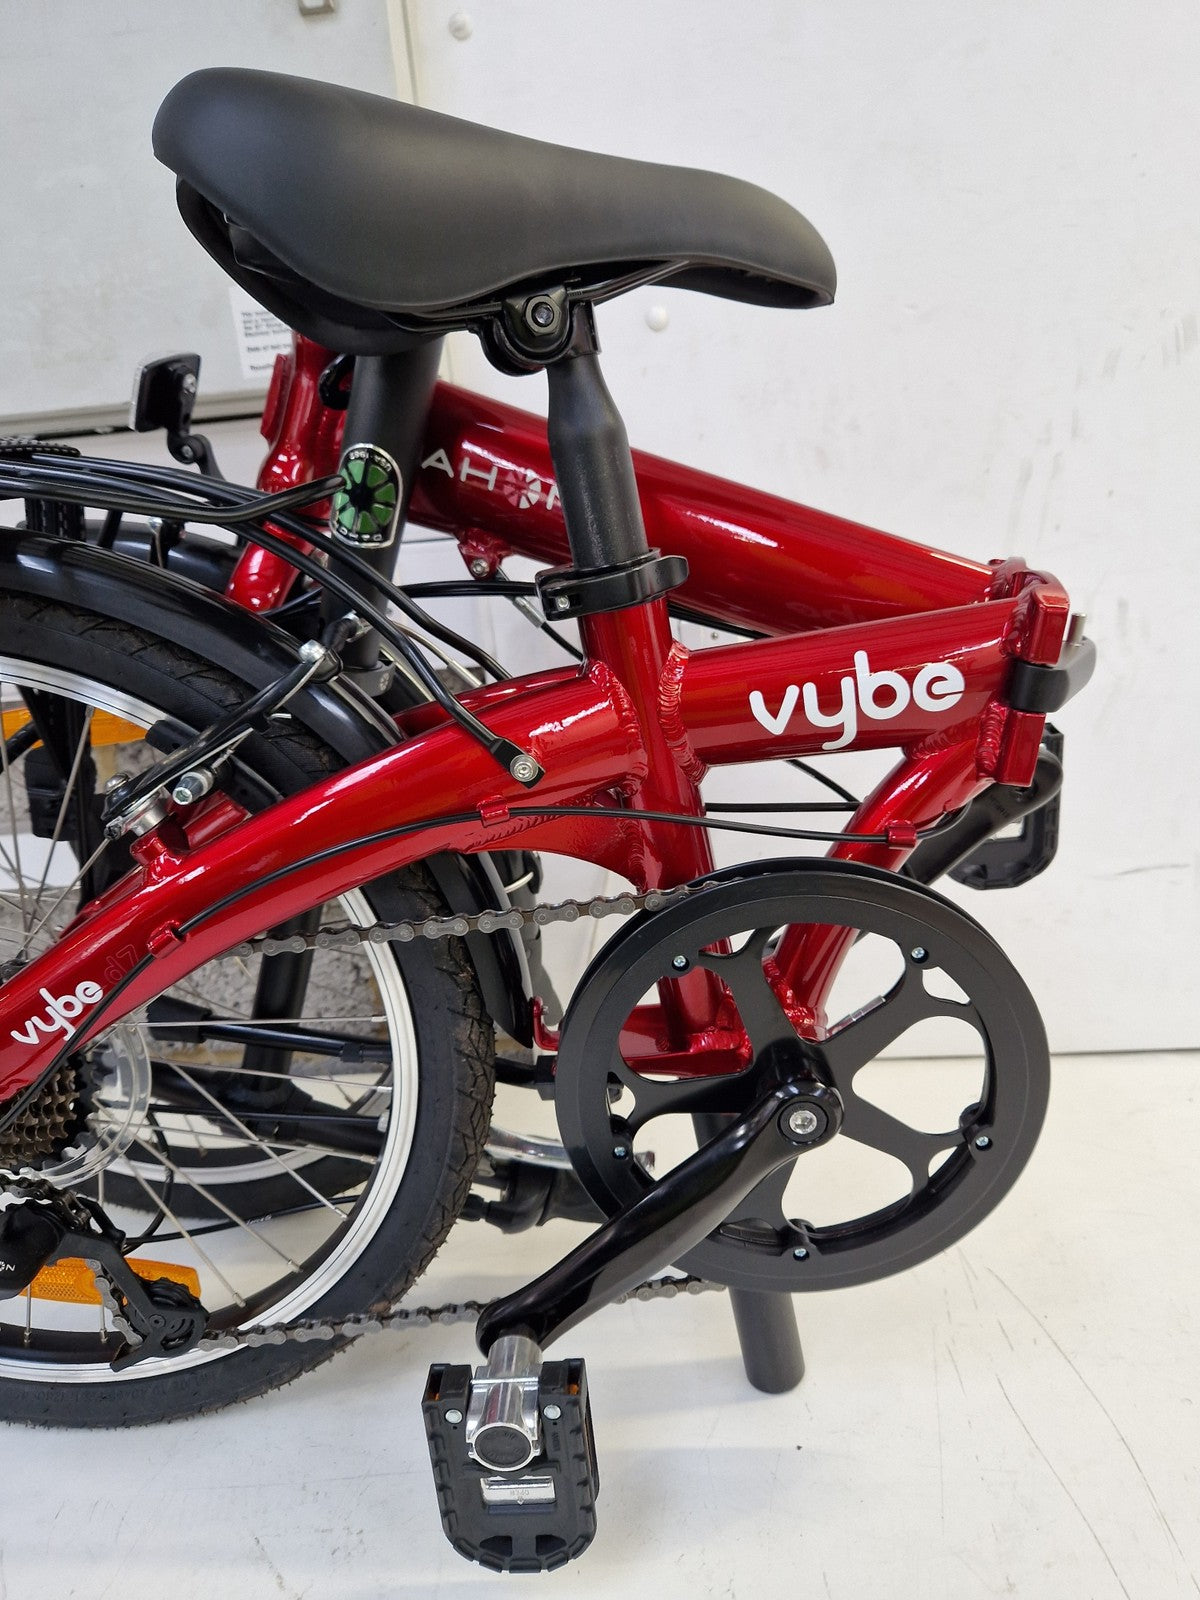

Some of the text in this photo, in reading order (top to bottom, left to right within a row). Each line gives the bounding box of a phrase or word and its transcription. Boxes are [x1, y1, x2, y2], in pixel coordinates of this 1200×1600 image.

[748, 650, 965, 750] vybe
[104, 944, 139, 984] d7
[10, 981, 104, 1045] vybe
